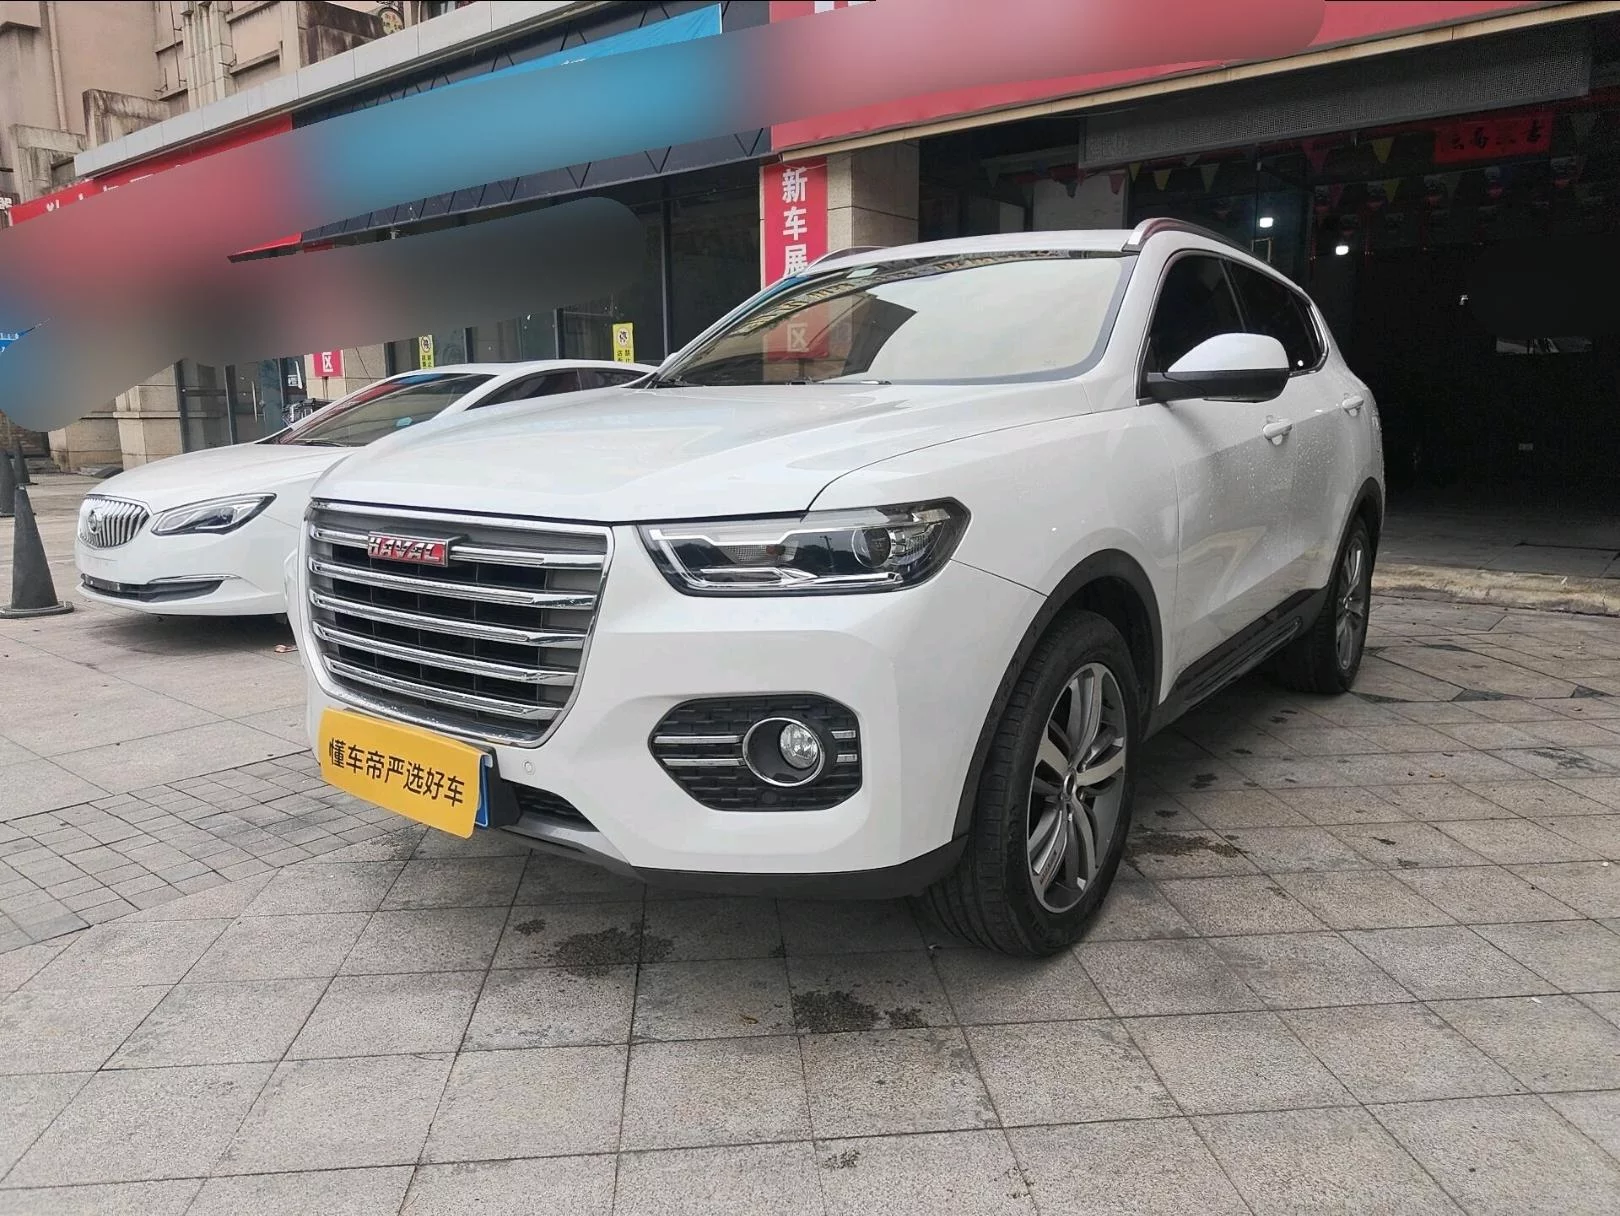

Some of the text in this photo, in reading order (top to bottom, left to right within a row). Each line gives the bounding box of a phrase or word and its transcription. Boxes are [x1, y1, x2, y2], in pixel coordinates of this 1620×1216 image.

[368, 536, 441, 562] HAVAL
[328, 737, 465, 808] 懂车帝严选好车
